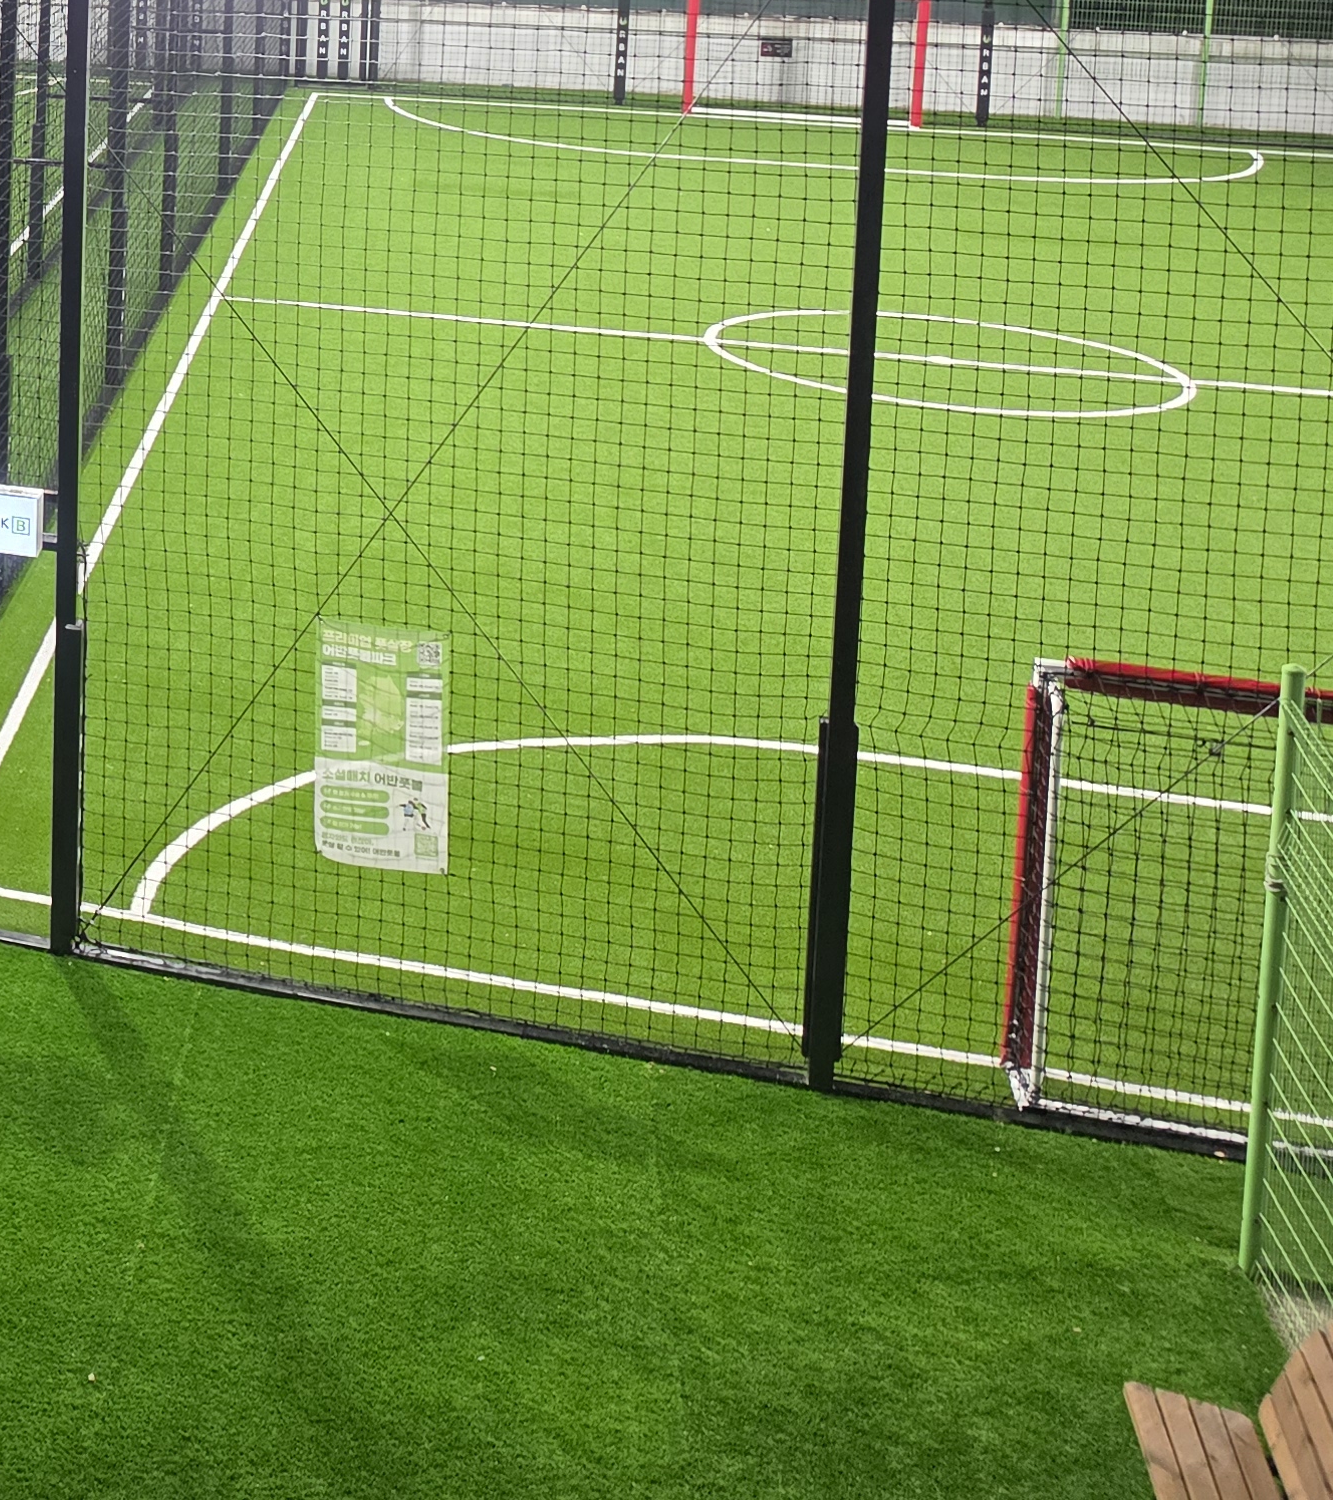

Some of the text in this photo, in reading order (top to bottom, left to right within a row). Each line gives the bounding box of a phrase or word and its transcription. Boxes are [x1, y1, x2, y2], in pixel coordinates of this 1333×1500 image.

[617, 17, 628, 77] URBAN
[980, 35, 991, 96] URBAN
[16, 519, 26, 532] B
